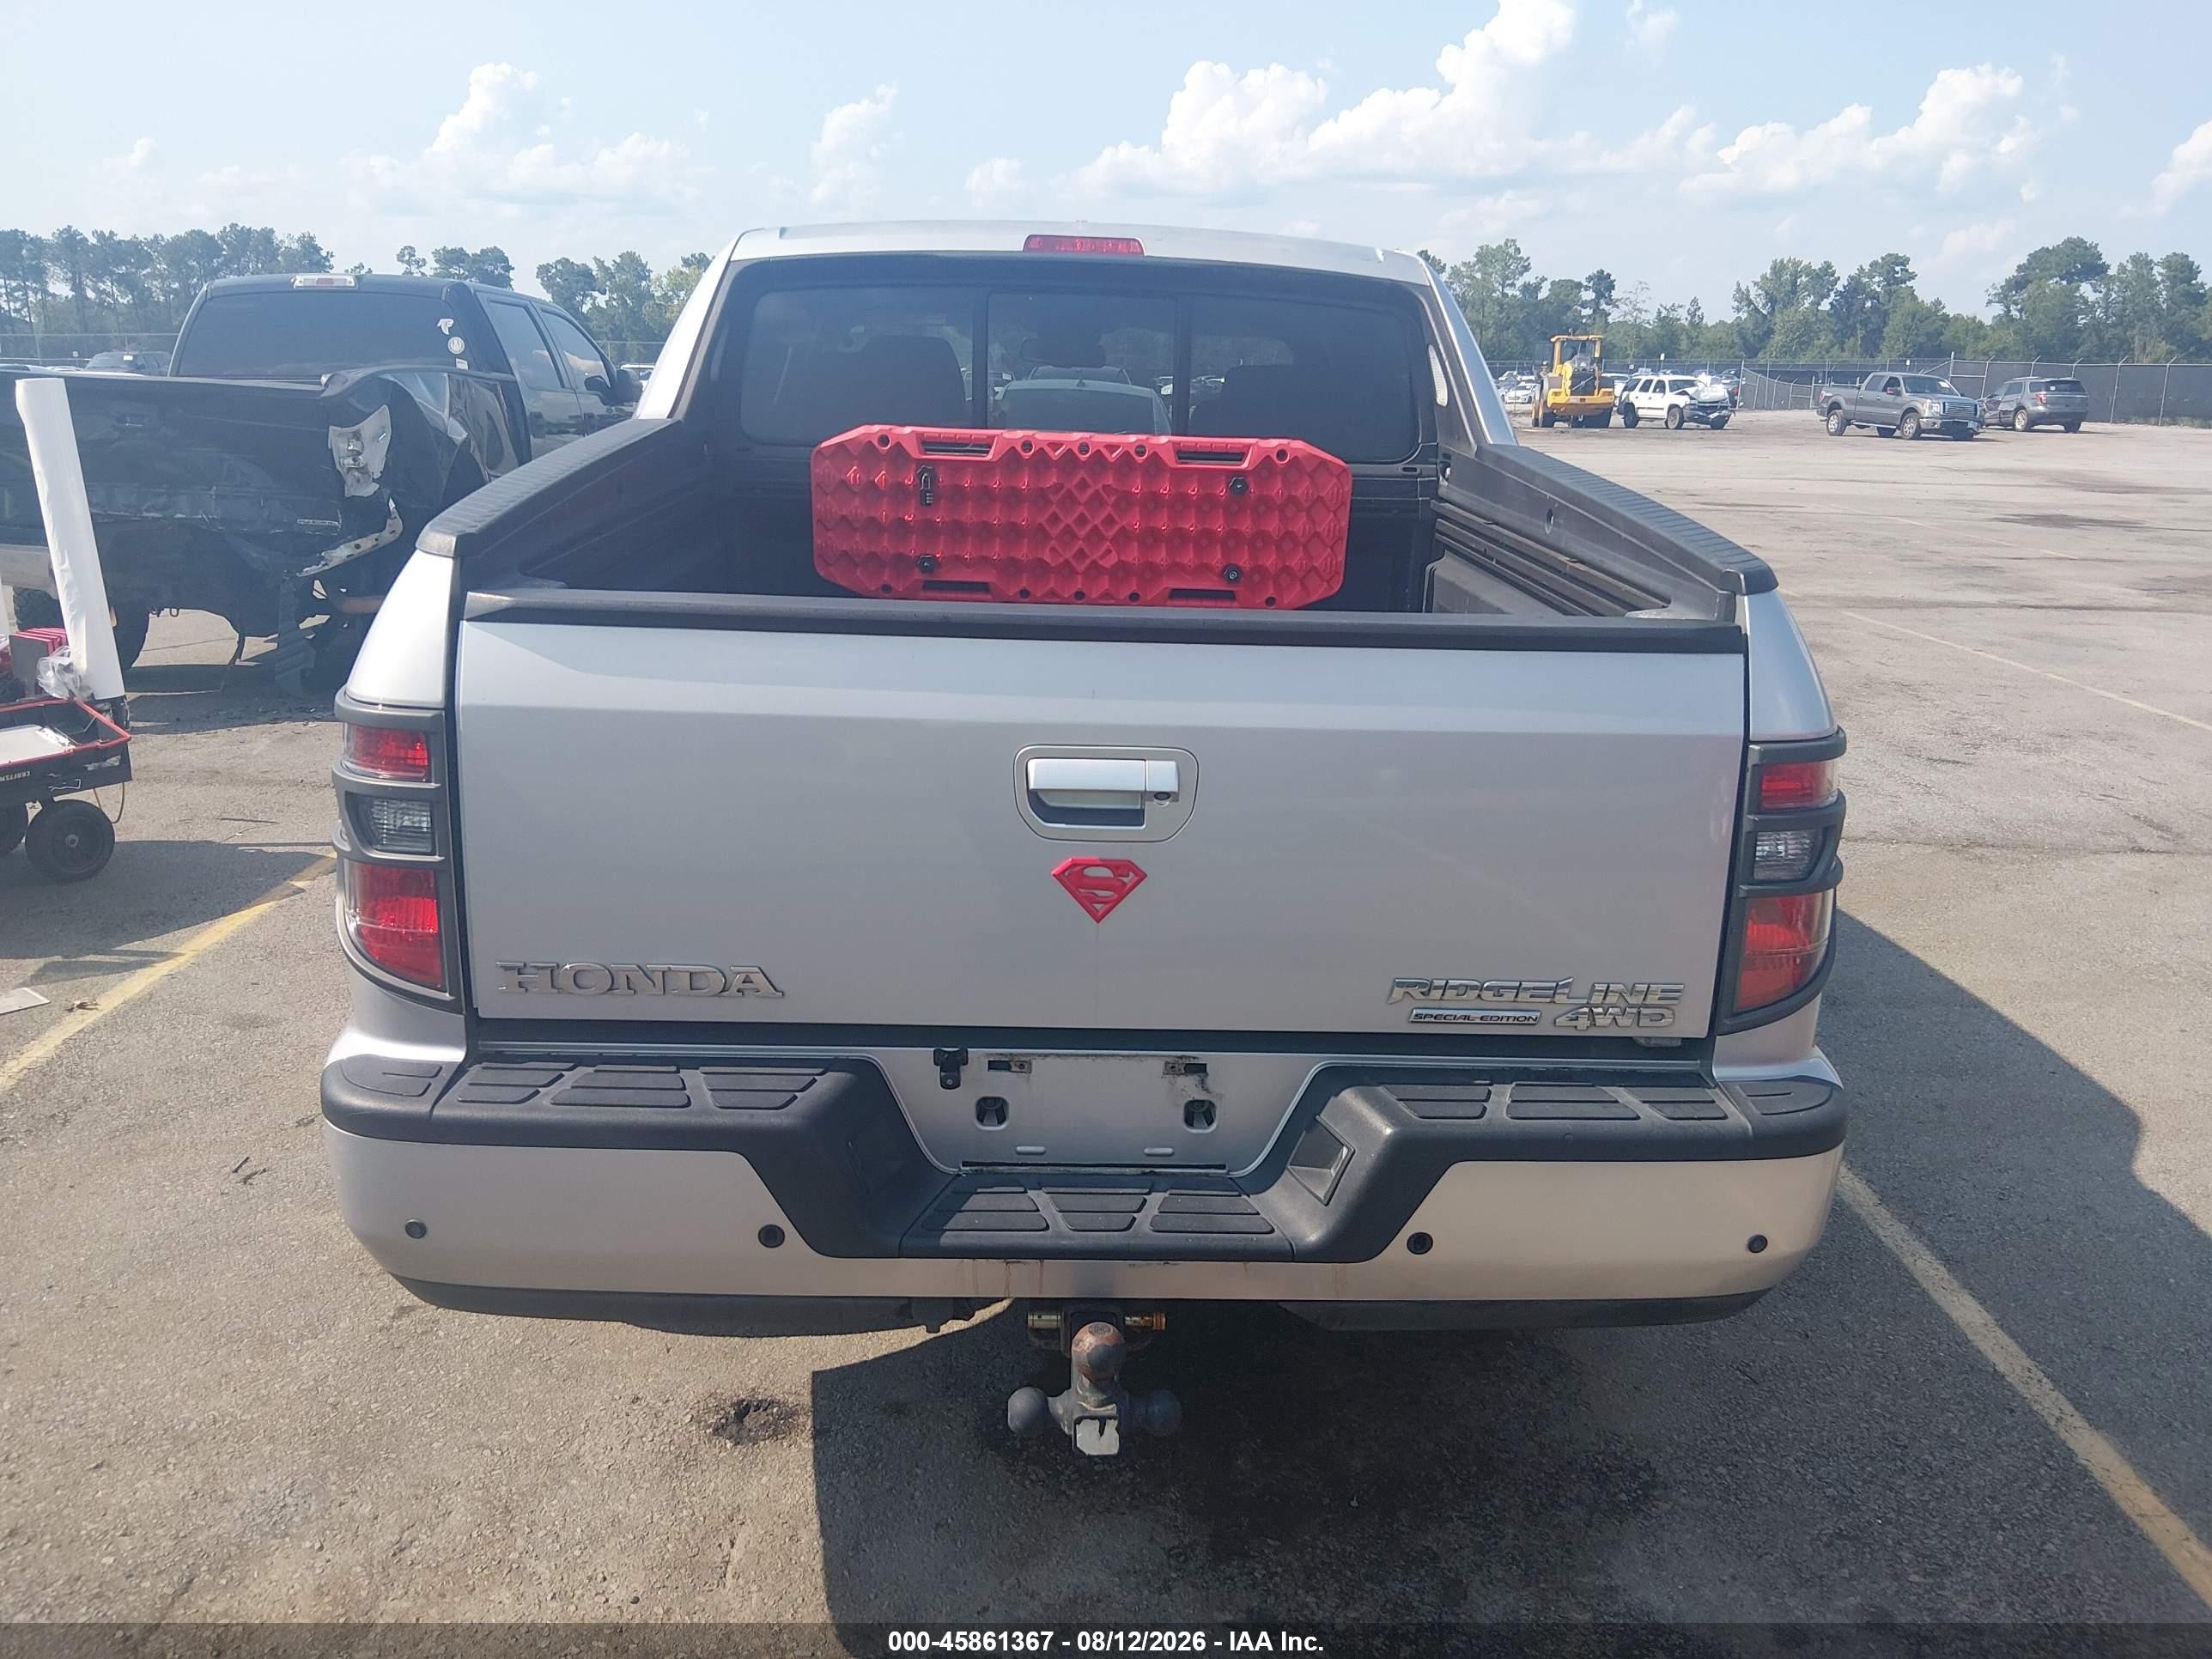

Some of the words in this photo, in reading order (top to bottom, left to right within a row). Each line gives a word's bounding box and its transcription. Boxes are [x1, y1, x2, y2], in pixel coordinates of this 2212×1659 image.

[495, 961, 784, 997] HONDA
[1387, 976, 1685, 1005] RIDGELINE
[1555, 1006, 1675, 1030] 4WD
